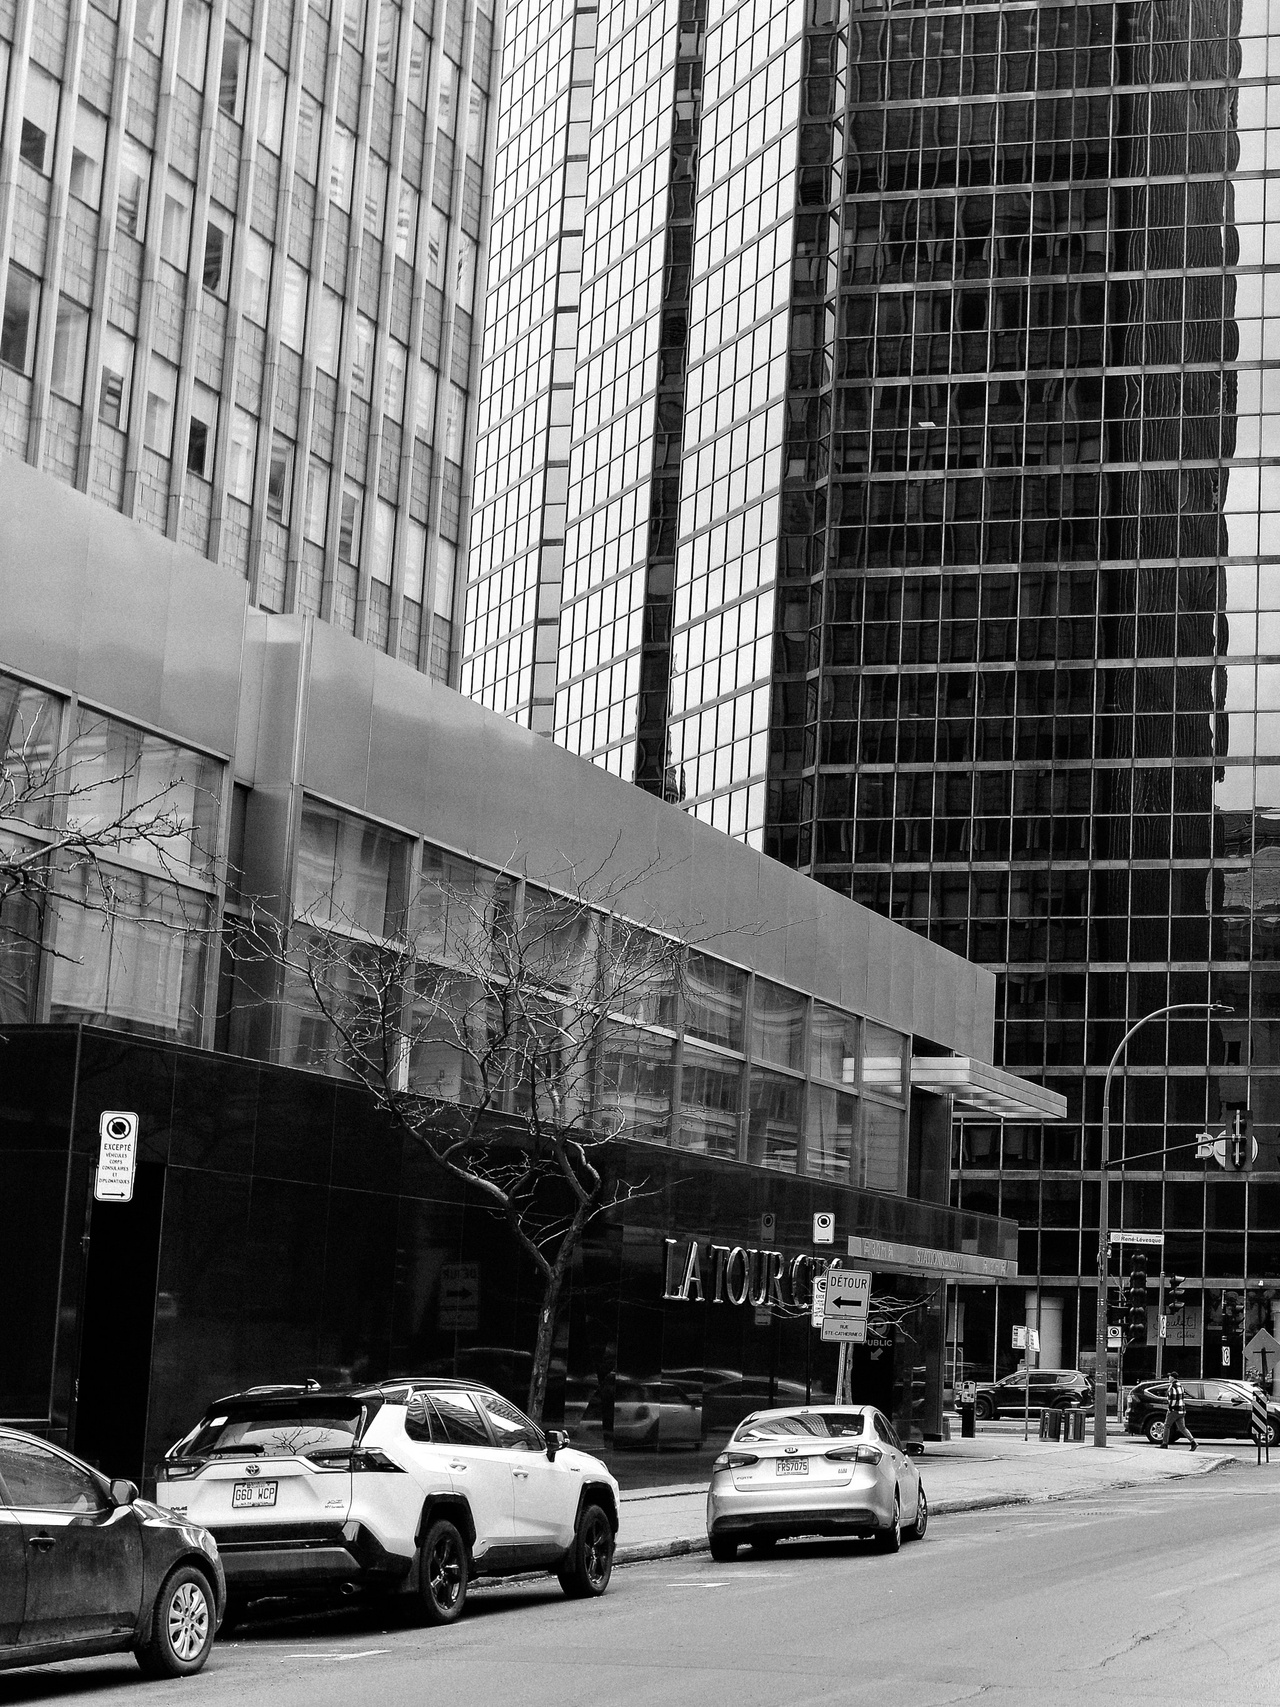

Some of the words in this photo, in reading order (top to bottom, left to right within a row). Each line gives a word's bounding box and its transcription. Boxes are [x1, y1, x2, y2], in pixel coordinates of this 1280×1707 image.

[104, 1143, 131, 1151] EXCEPTÉ
[830, 1274, 868, 1290] DÉTOUR
[863, 1339, 893, 1347] UBLIC
[777, 1461, 808, 1472] FRS7075
[257, 1487, 275, 1499] WCP
